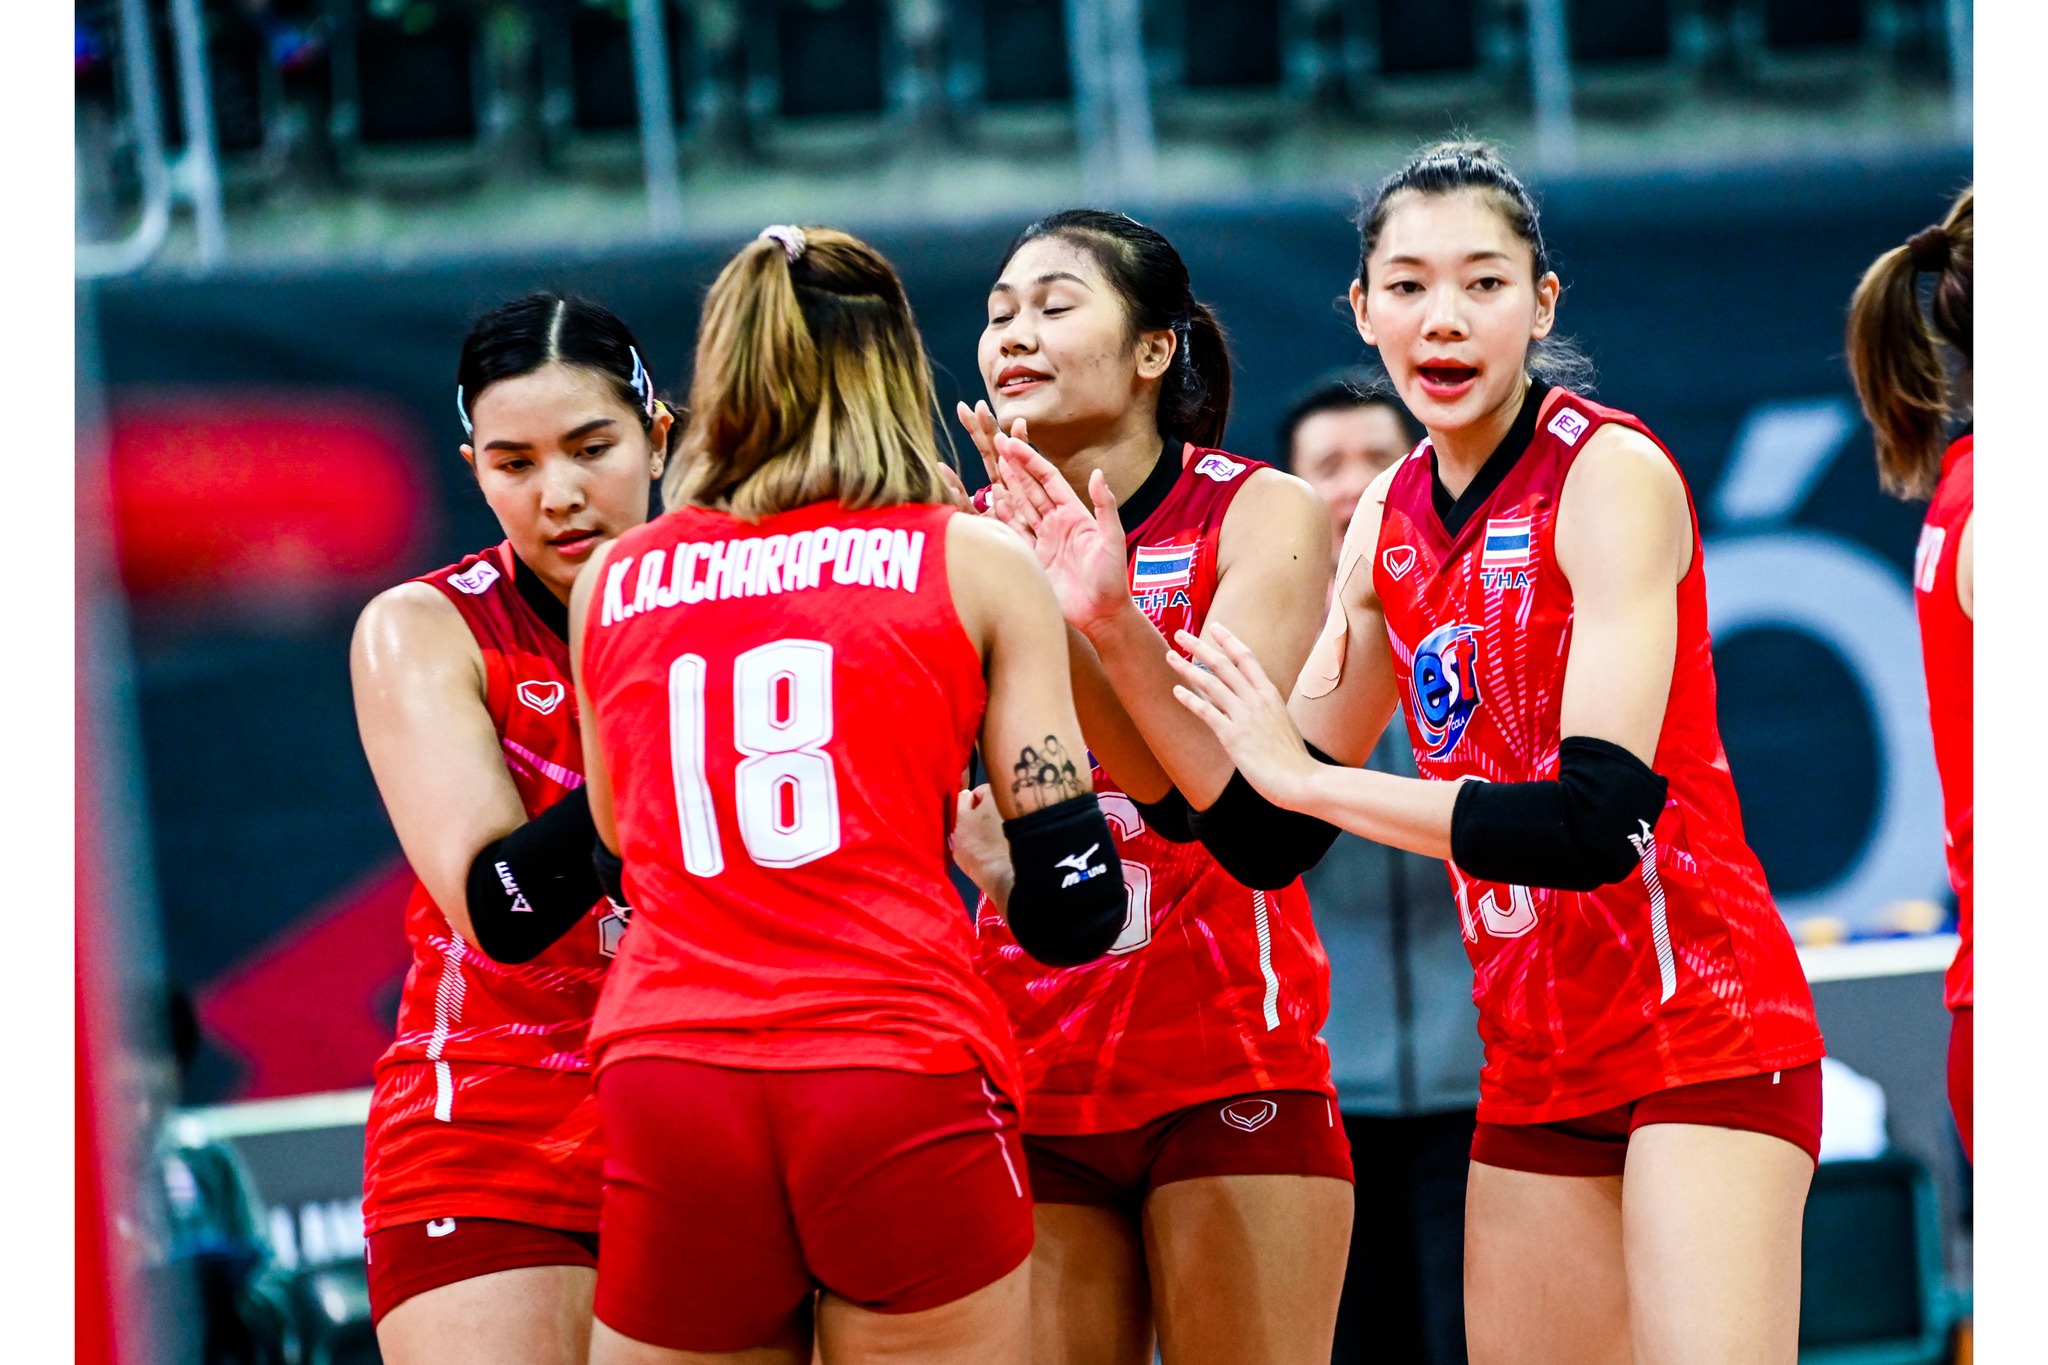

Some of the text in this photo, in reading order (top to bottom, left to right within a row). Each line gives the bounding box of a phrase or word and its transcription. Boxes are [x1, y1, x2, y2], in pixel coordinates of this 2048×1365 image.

[1201, 459, 1235, 477] PEA
[601, 526, 925, 626] K.AJCHARAPORN
[1480, 570, 1530, 590] THA
[1132, 589, 1191, 610] THA
[669, 638, 840, 877] 18
